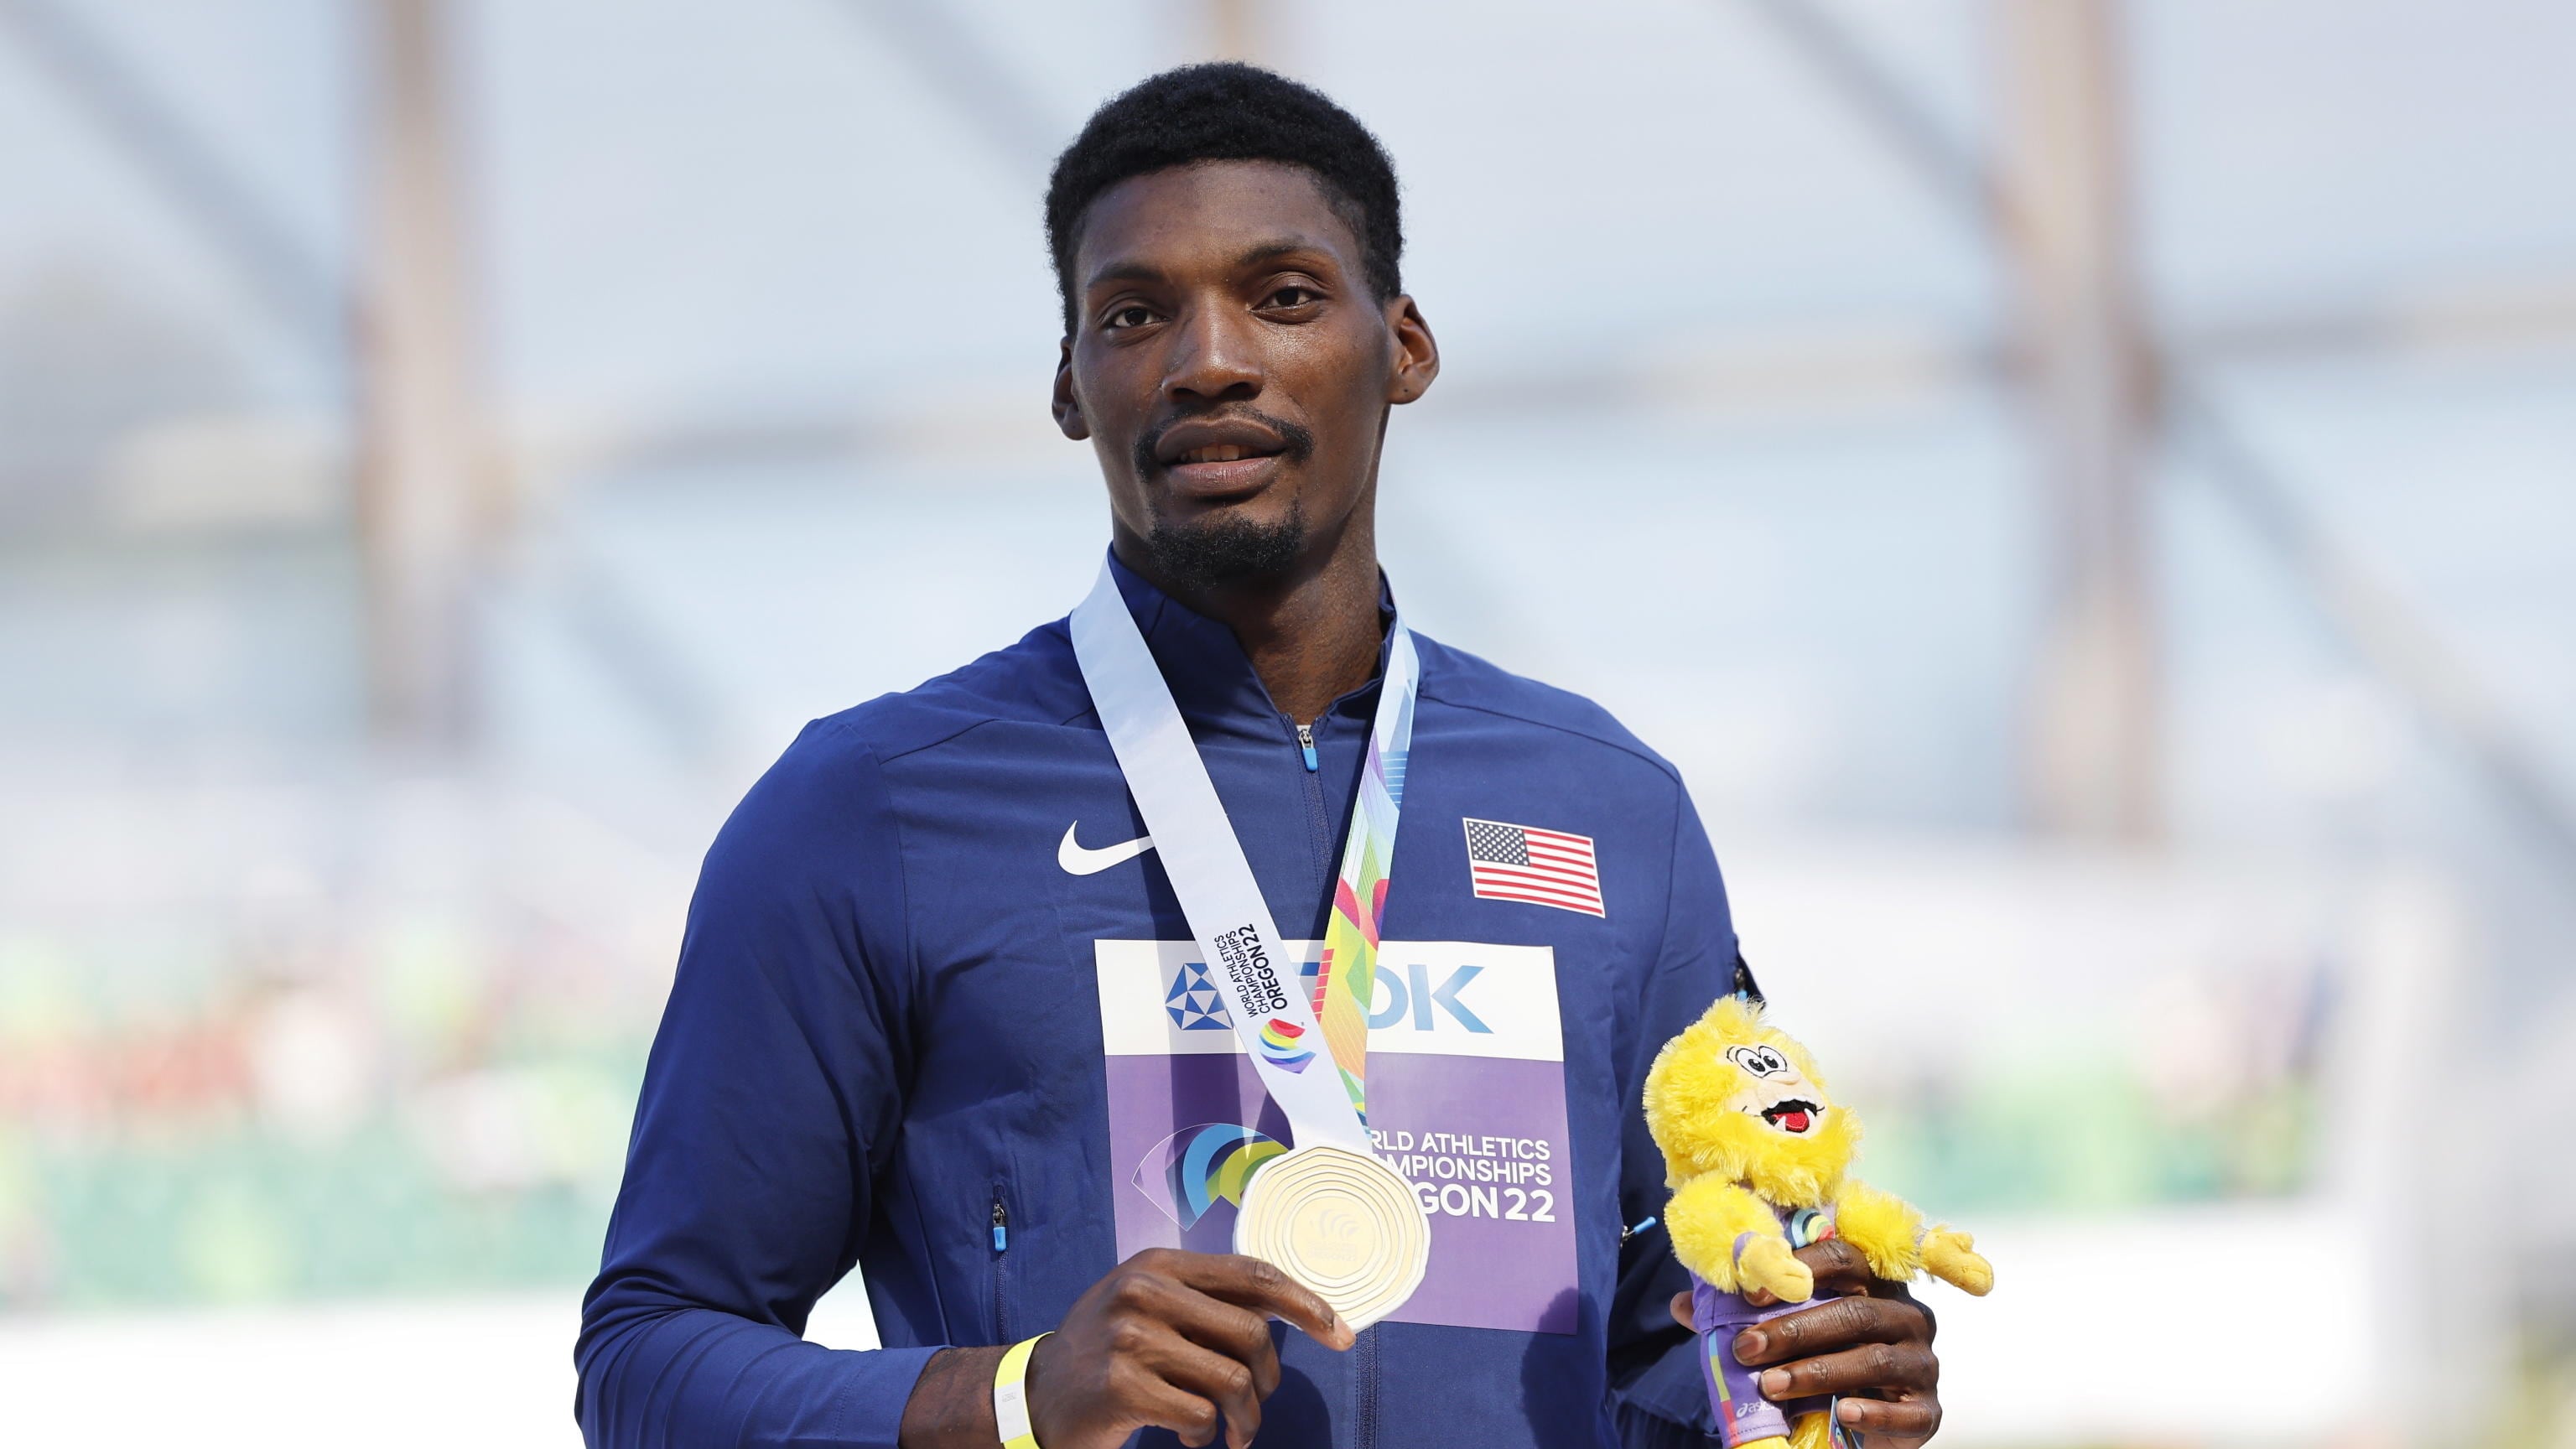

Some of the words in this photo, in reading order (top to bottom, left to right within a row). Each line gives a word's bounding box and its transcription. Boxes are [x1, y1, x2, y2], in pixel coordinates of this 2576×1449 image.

[1238, 923, 1259, 947] 22
[1214, 934, 1244, 984] ATHLETICS
[1225, 930, 1270, 1014] CHAMPIONSHIPS
[1247, 944, 1288, 1010] OREGON
[1236, 984, 1259, 1018] WORLD
[1371, 1130, 1415, 1151] RLD
[1420, 1132, 1550, 1161] ATHLETICS
[1374, 1154, 1552, 1186] MPIONSHIPS
[1413, 1181, 1499, 1219] GON
[1503, 1187, 1555, 1223] 22
